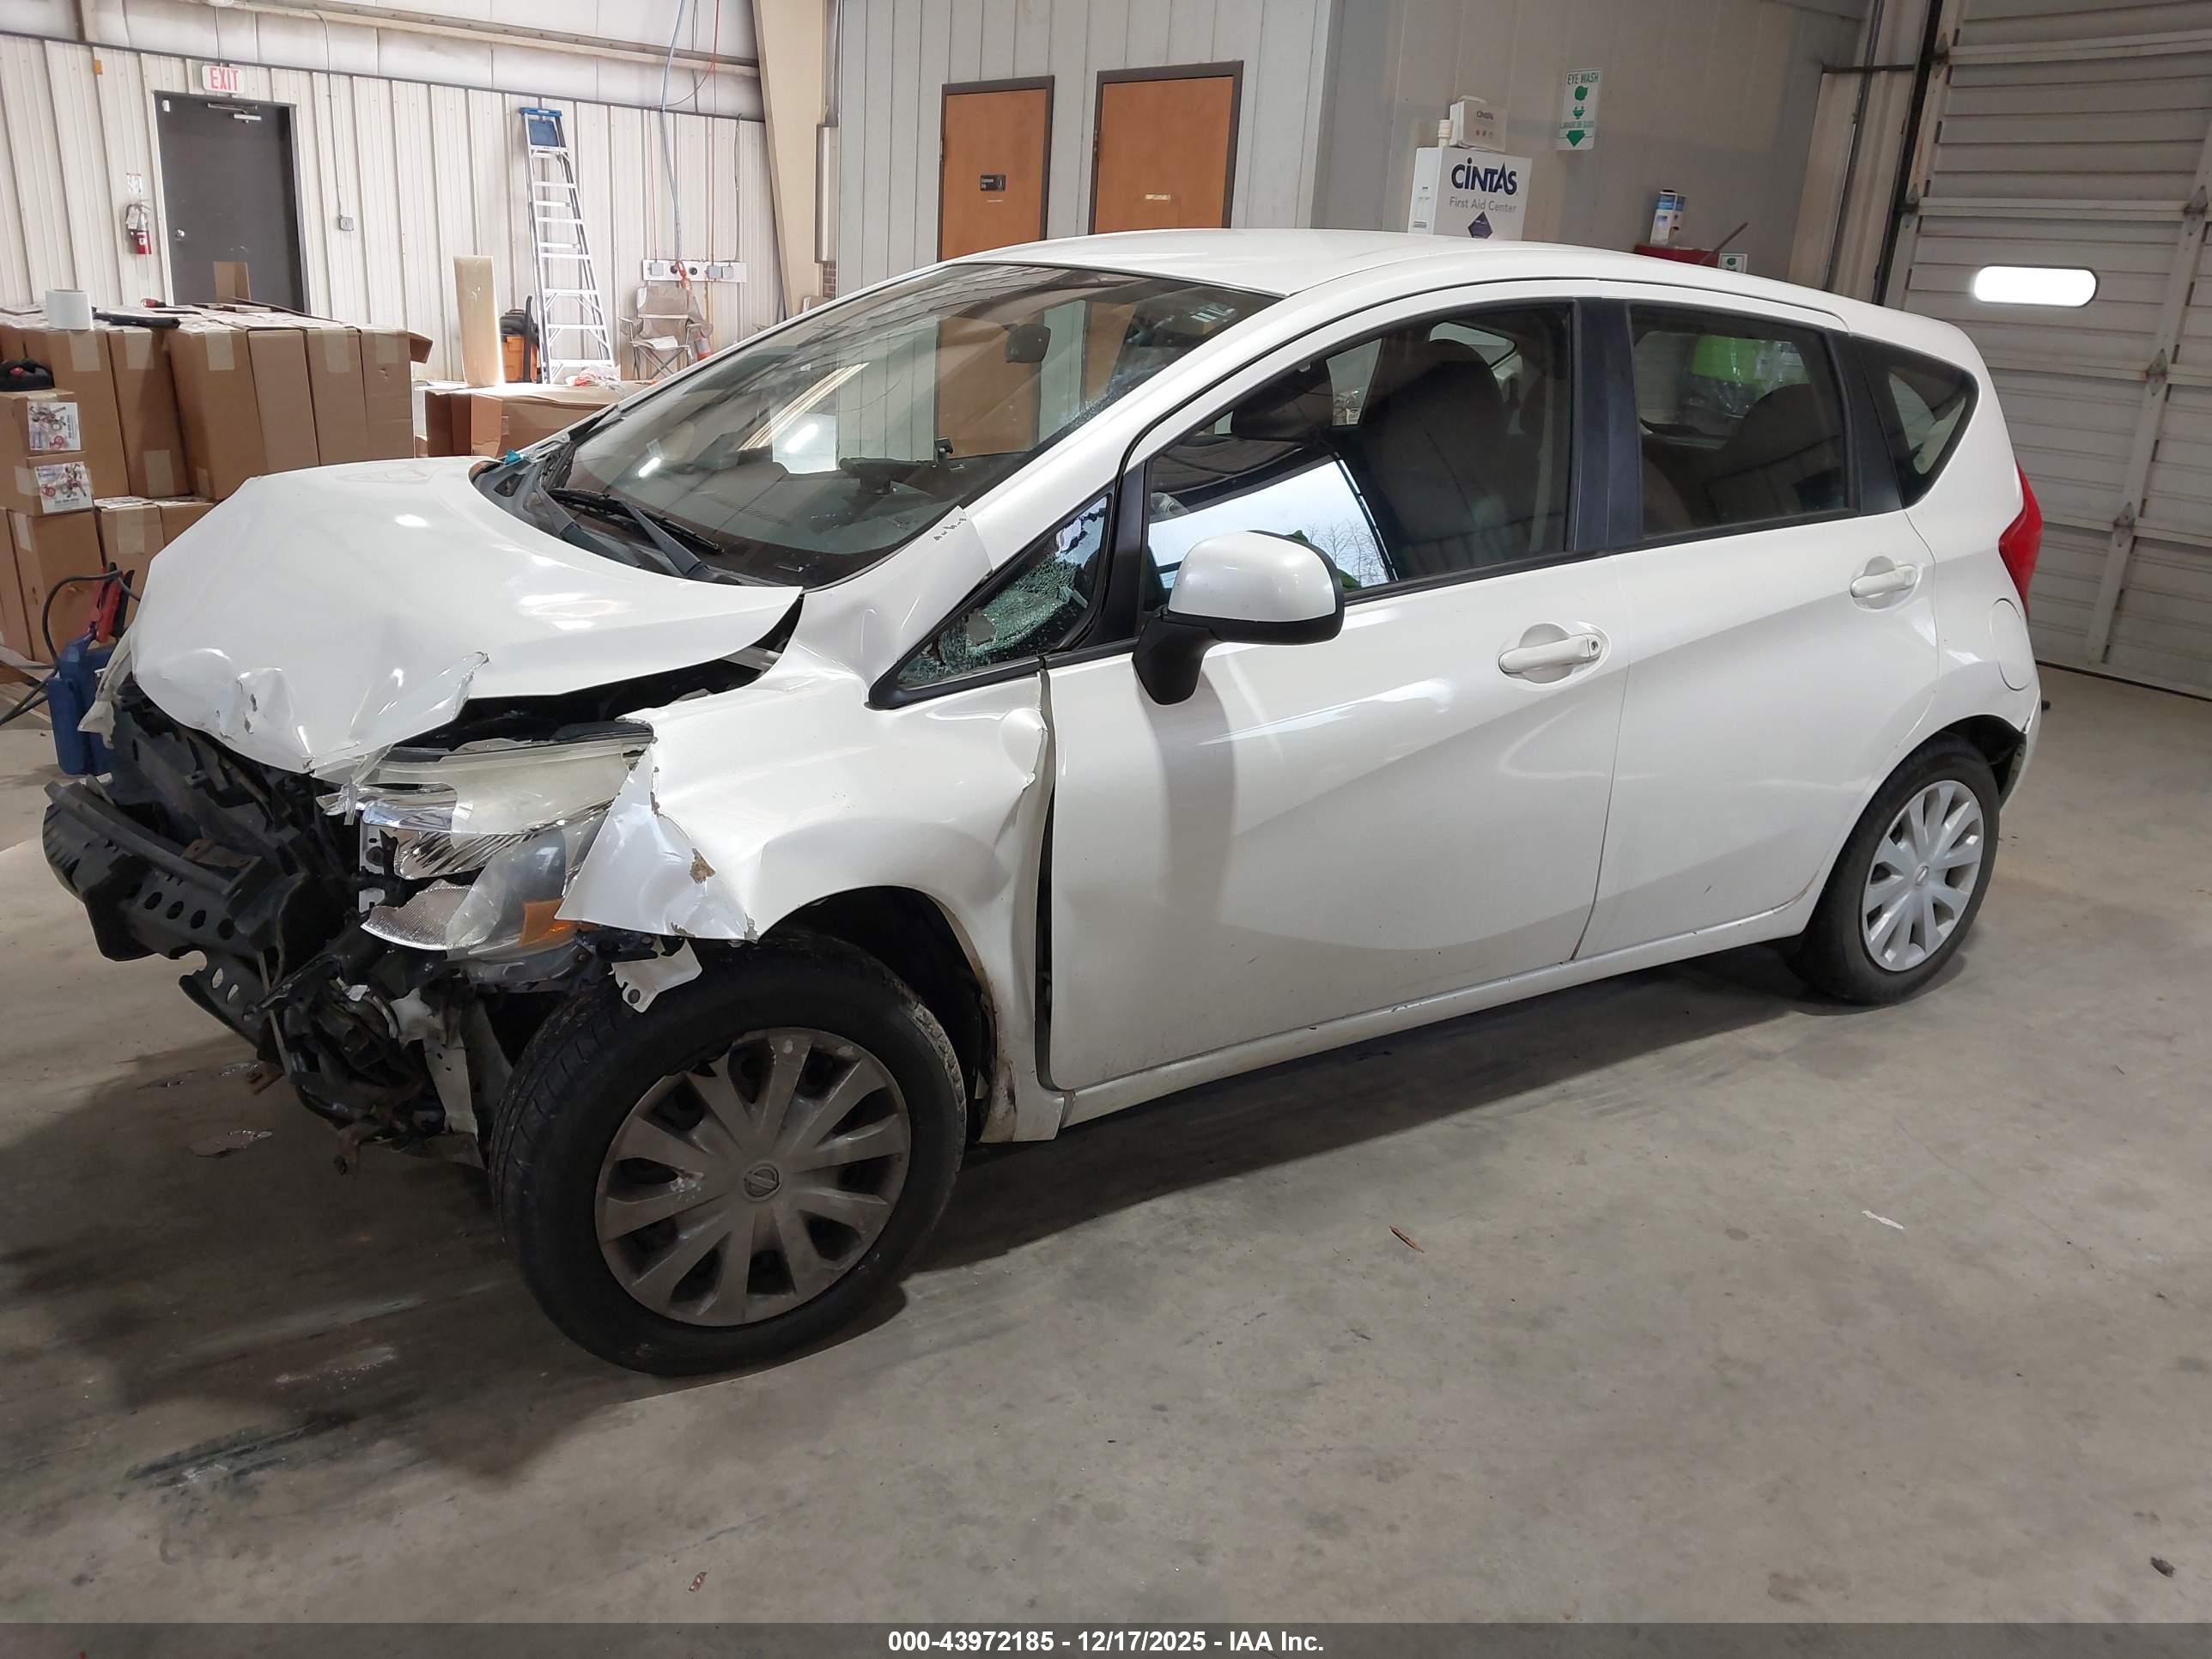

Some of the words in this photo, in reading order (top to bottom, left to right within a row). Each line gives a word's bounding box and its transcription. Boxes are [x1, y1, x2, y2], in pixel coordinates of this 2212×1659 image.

[210, 66, 239, 91] EXIT
[1567, 74, 1580, 85] EYE
[1581, 72, 1599, 84] WASH
[1449, 196, 1468, 208] First
[1471, 198, 1486, 210] Aid
[1488, 200, 1517, 213] Center
